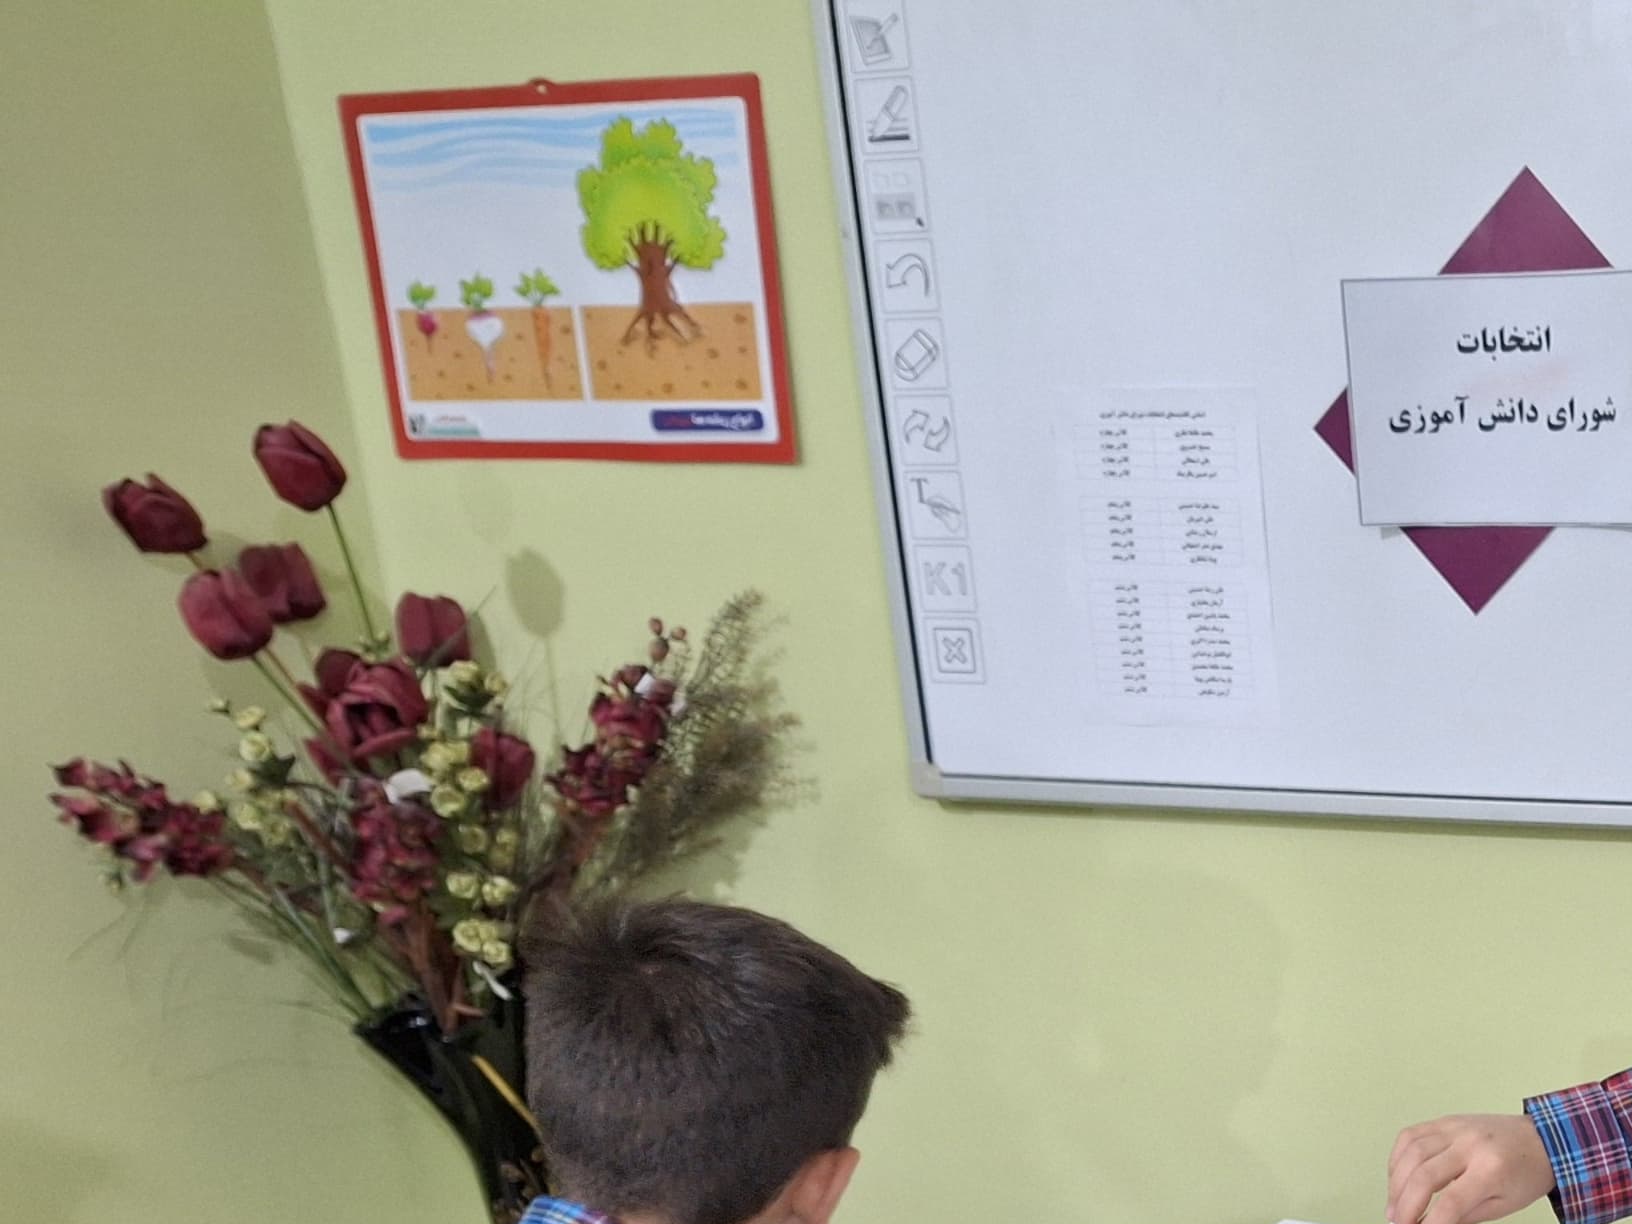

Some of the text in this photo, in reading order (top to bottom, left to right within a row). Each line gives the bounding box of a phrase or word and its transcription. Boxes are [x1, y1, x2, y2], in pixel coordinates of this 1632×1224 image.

[1456, 325, 1551, 361] انتخابات
[1389, 395, 1616, 433] شورای دانش آموزی
